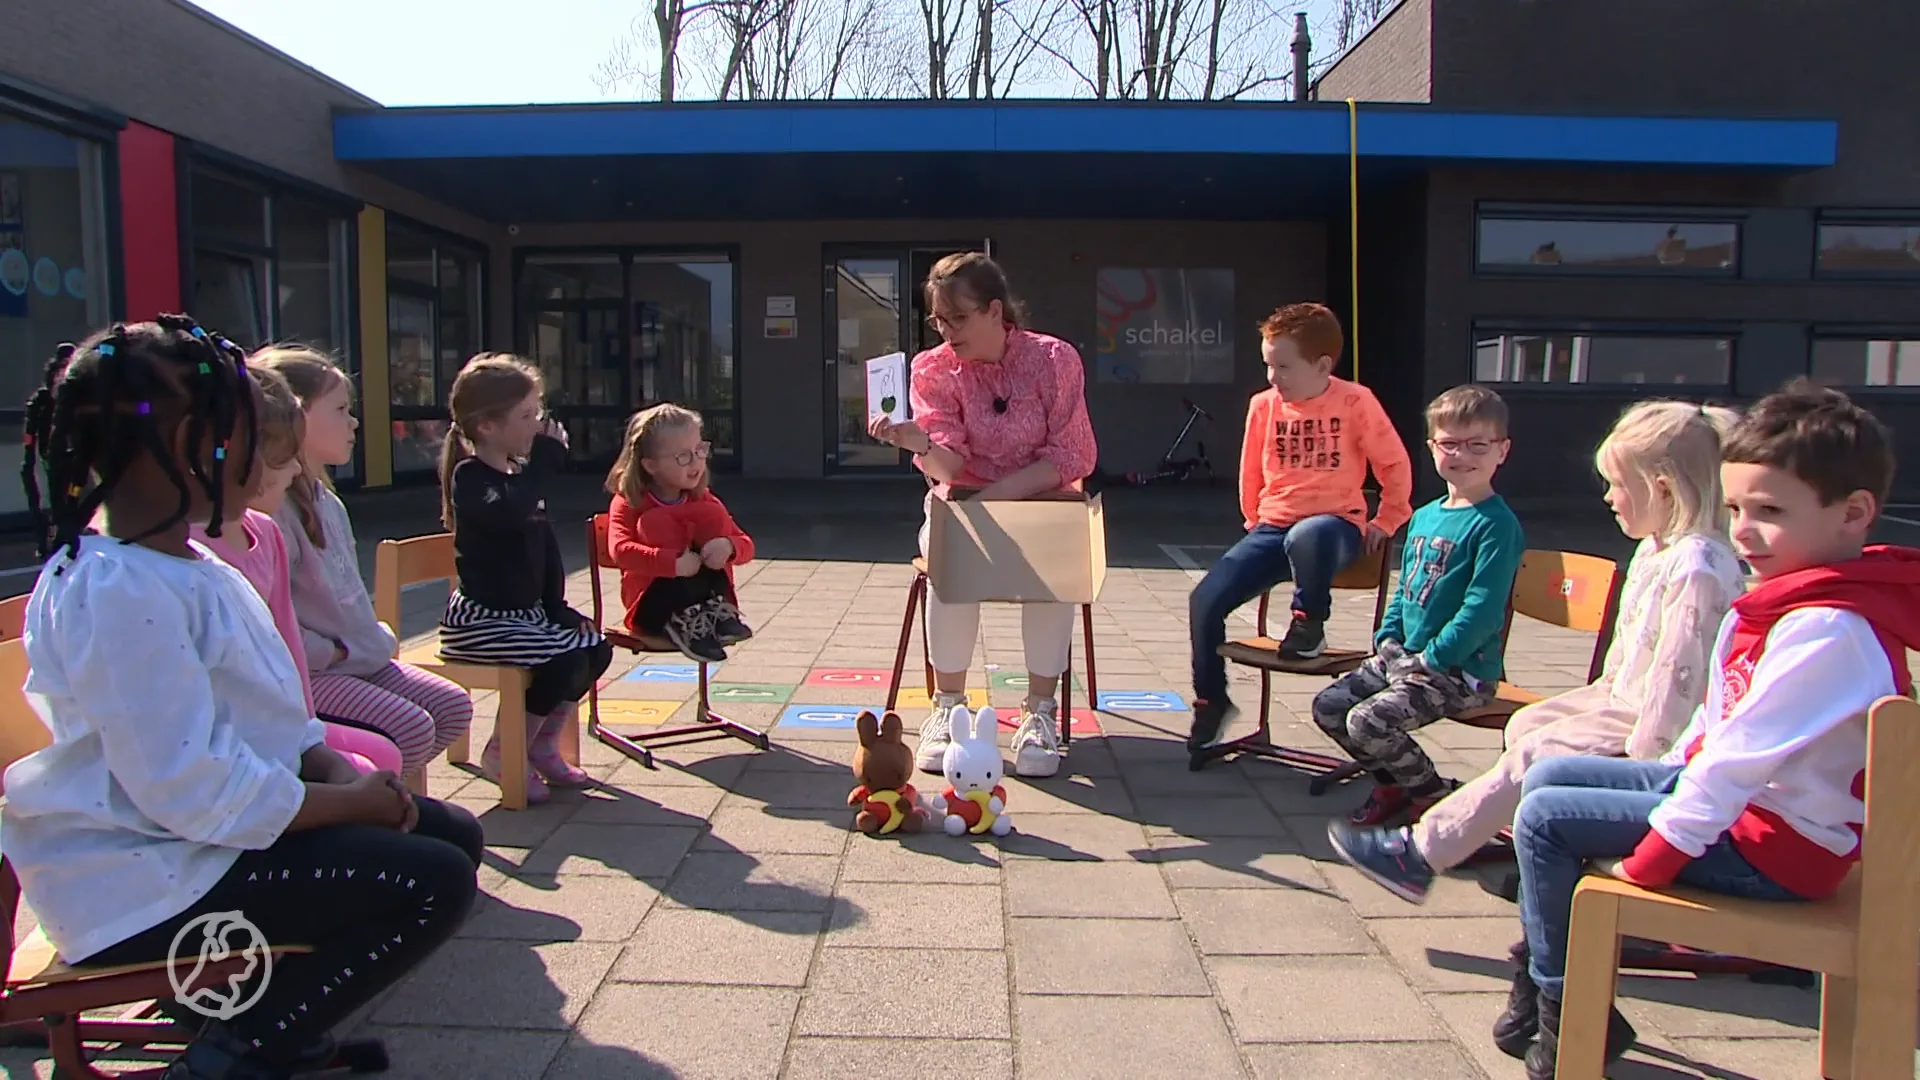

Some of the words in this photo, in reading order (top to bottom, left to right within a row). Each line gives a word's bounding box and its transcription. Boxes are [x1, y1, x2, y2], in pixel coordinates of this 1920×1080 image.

[1125, 319, 1222, 345] schakel
[1275, 417, 1341, 436] WORLD
[1275, 435, 1341, 453] SPORT
[248, 869, 292, 881] AIR
[314, 867, 356, 879] AIR
[377, 870, 416, 889] AIR
[368, 933, 403, 961] AIR
[322, 967, 354, 996] AIR
[277, 1002, 309, 1031] AIR
